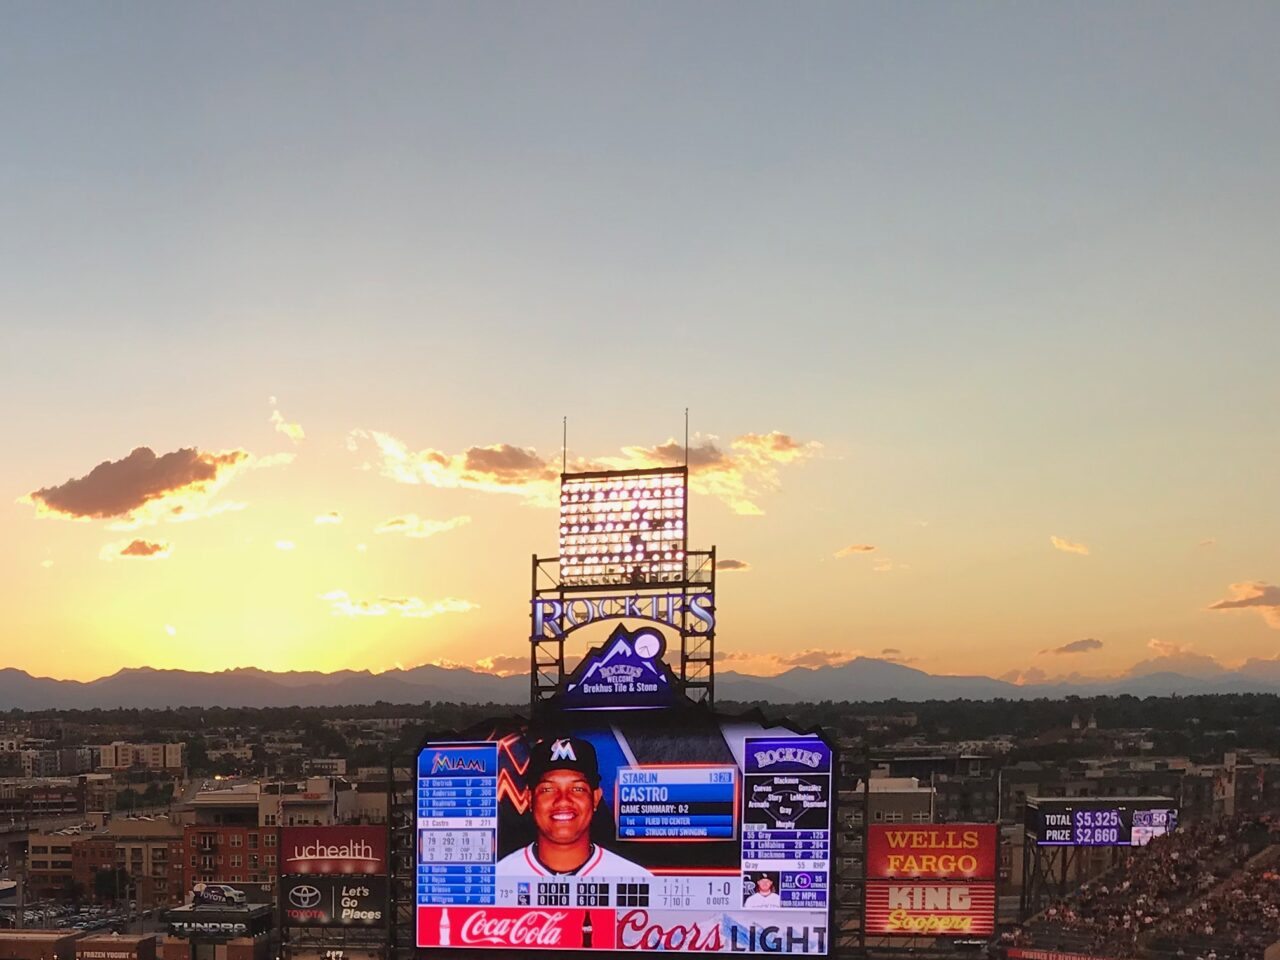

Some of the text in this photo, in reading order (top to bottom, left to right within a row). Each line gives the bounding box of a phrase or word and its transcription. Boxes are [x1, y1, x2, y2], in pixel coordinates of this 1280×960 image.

[532, 592, 716, 639] ROCKIES
[599, 664, 643, 679] ROCKIES
[583, 683, 657, 693] Brekhus Tile & Stone
[431, 752, 486, 774] MIAMI
[753, 747, 822, 769] ROCKIES
[622, 773, 658, 784] STARLIN
[621, 787, 668, 802] CASTRO
[620, 805, 689, 814] GAME SUMMARY: 0-2
[779, 806, 792, 815] Gray
[669, 817, 690, 825] CENTER
[1045, 811, 1118, 828] TOTAL $5,325
[1152, 813, 1167, 822] 50
[758, 832, 772, 840] Gray
[885, 831, 979, 849] WELLS
[1046, 828, 1117, 845] PRIZE $2,660
[294, 839, 373, 858] uchealth
[887, 855, 977, 873] FARGO
[341, 886, 370, 896] Let's
[540, 885, 595, 893] 0 0 0 0
[580, 897, 584, 905] 6
[590, 897, 595, 905] 0
[713, 897, 729, 905] OUTS
[791, 892, 800, 900] 92
[888, 887, 971, 910] KING
[341, 897, 358, 907] Go
[287, 909, 326, 918] TOYOTA
[341, 909, 381, 920] Places
[171, 922, 248, 932] TUNDRA
[887, 909, 972, 934] Soopers
[461, 910, 569, 945] Coca-Cola
[617, 909, 827, 953] Coors LIGHT
